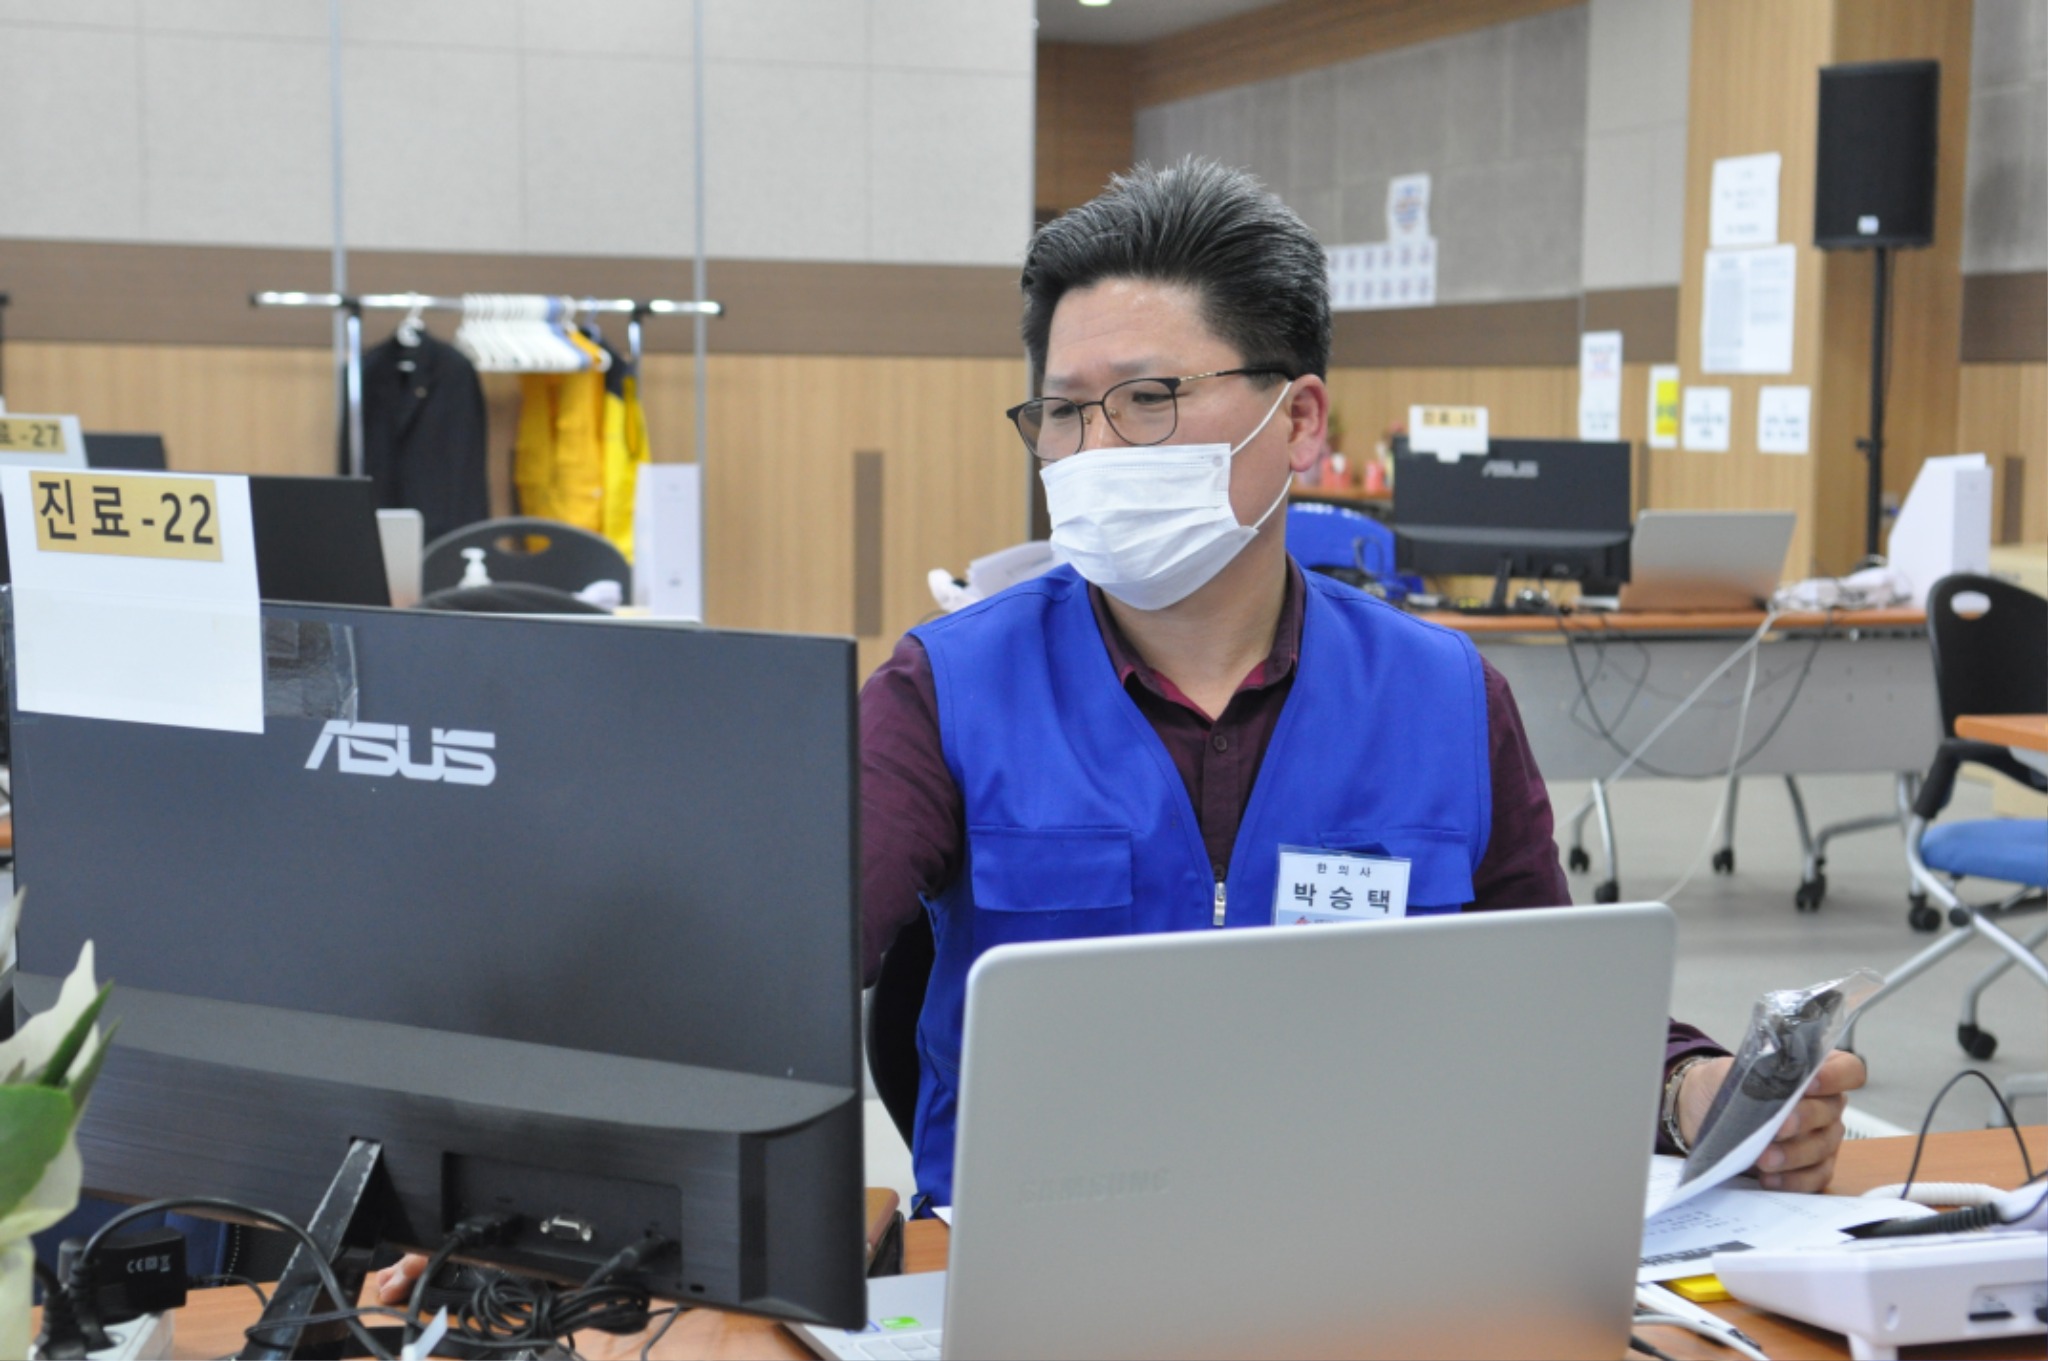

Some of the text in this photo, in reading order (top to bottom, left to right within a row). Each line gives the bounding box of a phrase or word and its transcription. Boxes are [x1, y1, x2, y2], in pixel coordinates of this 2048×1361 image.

[1482, 460, 1538, 478] ASUS
[38, 479, 214, 545] 진료-22
[304, 719, 496, 786] ASUS
[1018, 1166, 1172, 1206] SAMSUNG
